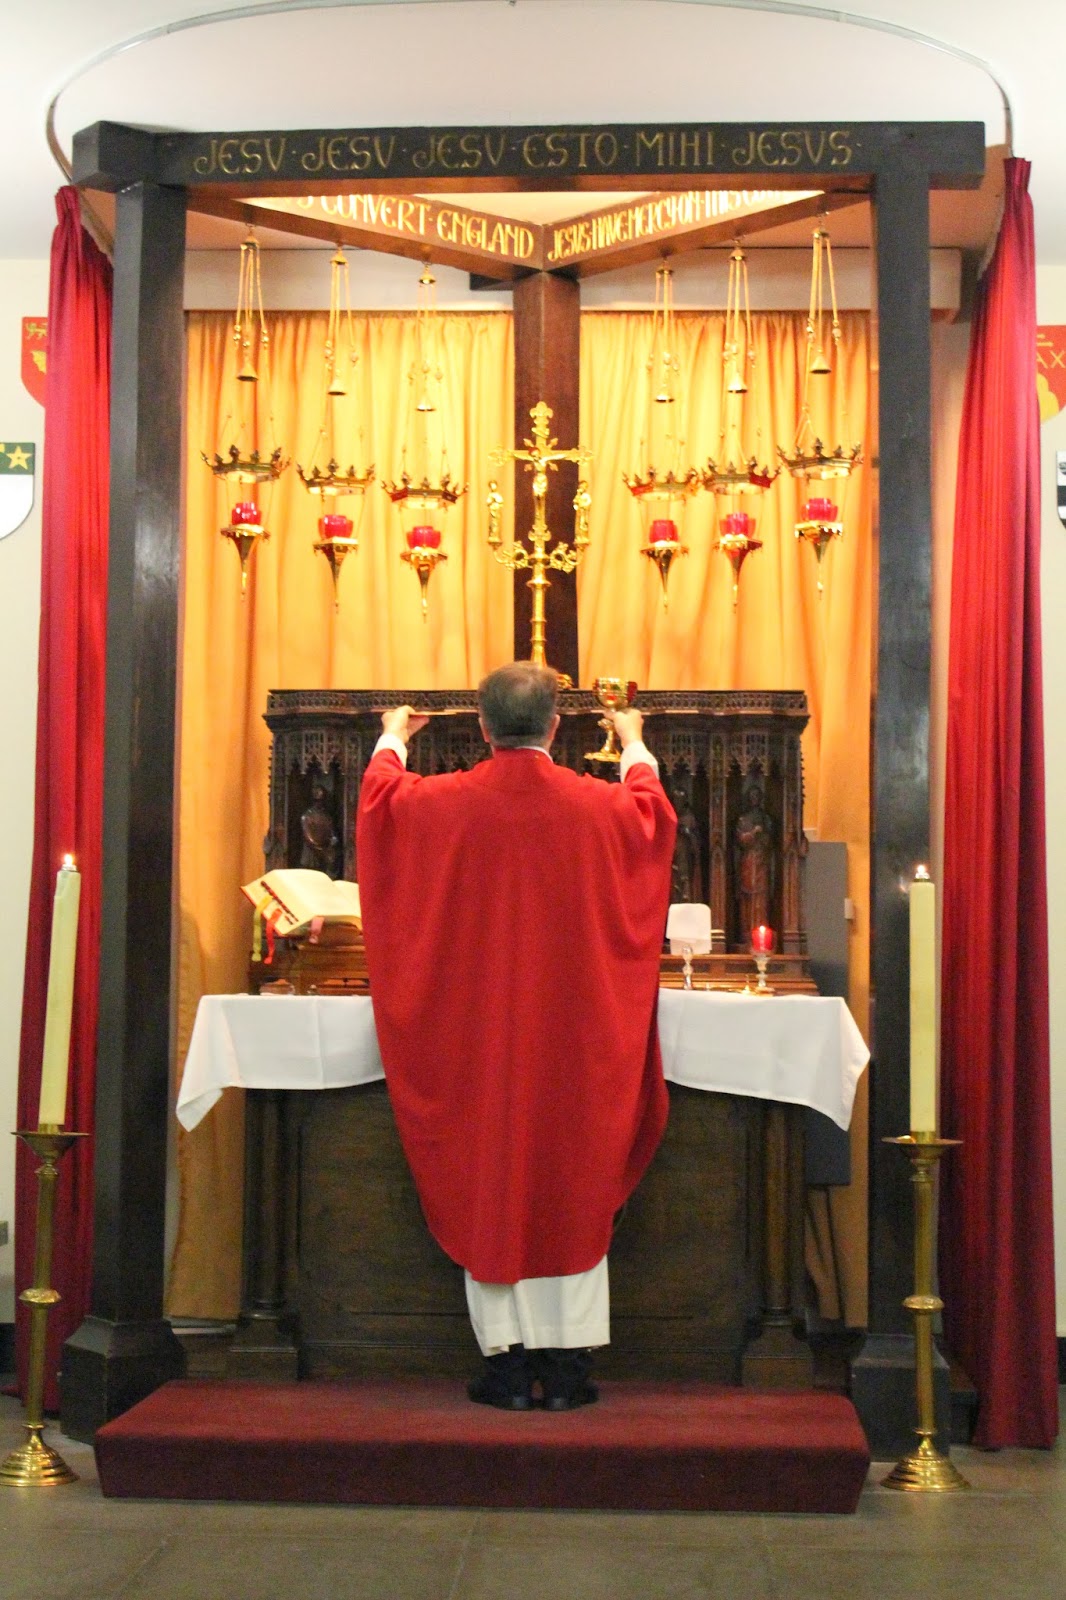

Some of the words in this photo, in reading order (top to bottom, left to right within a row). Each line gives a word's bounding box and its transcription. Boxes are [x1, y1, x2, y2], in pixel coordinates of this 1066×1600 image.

[193, 137, 286, 175] JESV
[301, 136, 397, 171] JESV
[412, 134, 507, 169] JESV
[523, 133, 618, 168] ESTO
[636, 131, 714, 166] MIHI
[732, 130, 852, 166] JESVS
[437, 208, 534, 259] ENGLAND
[592, 212, 627, 250] HAVE
[628, 195, 676, 240] MERCY
[678, 190, 700, 225] ON
